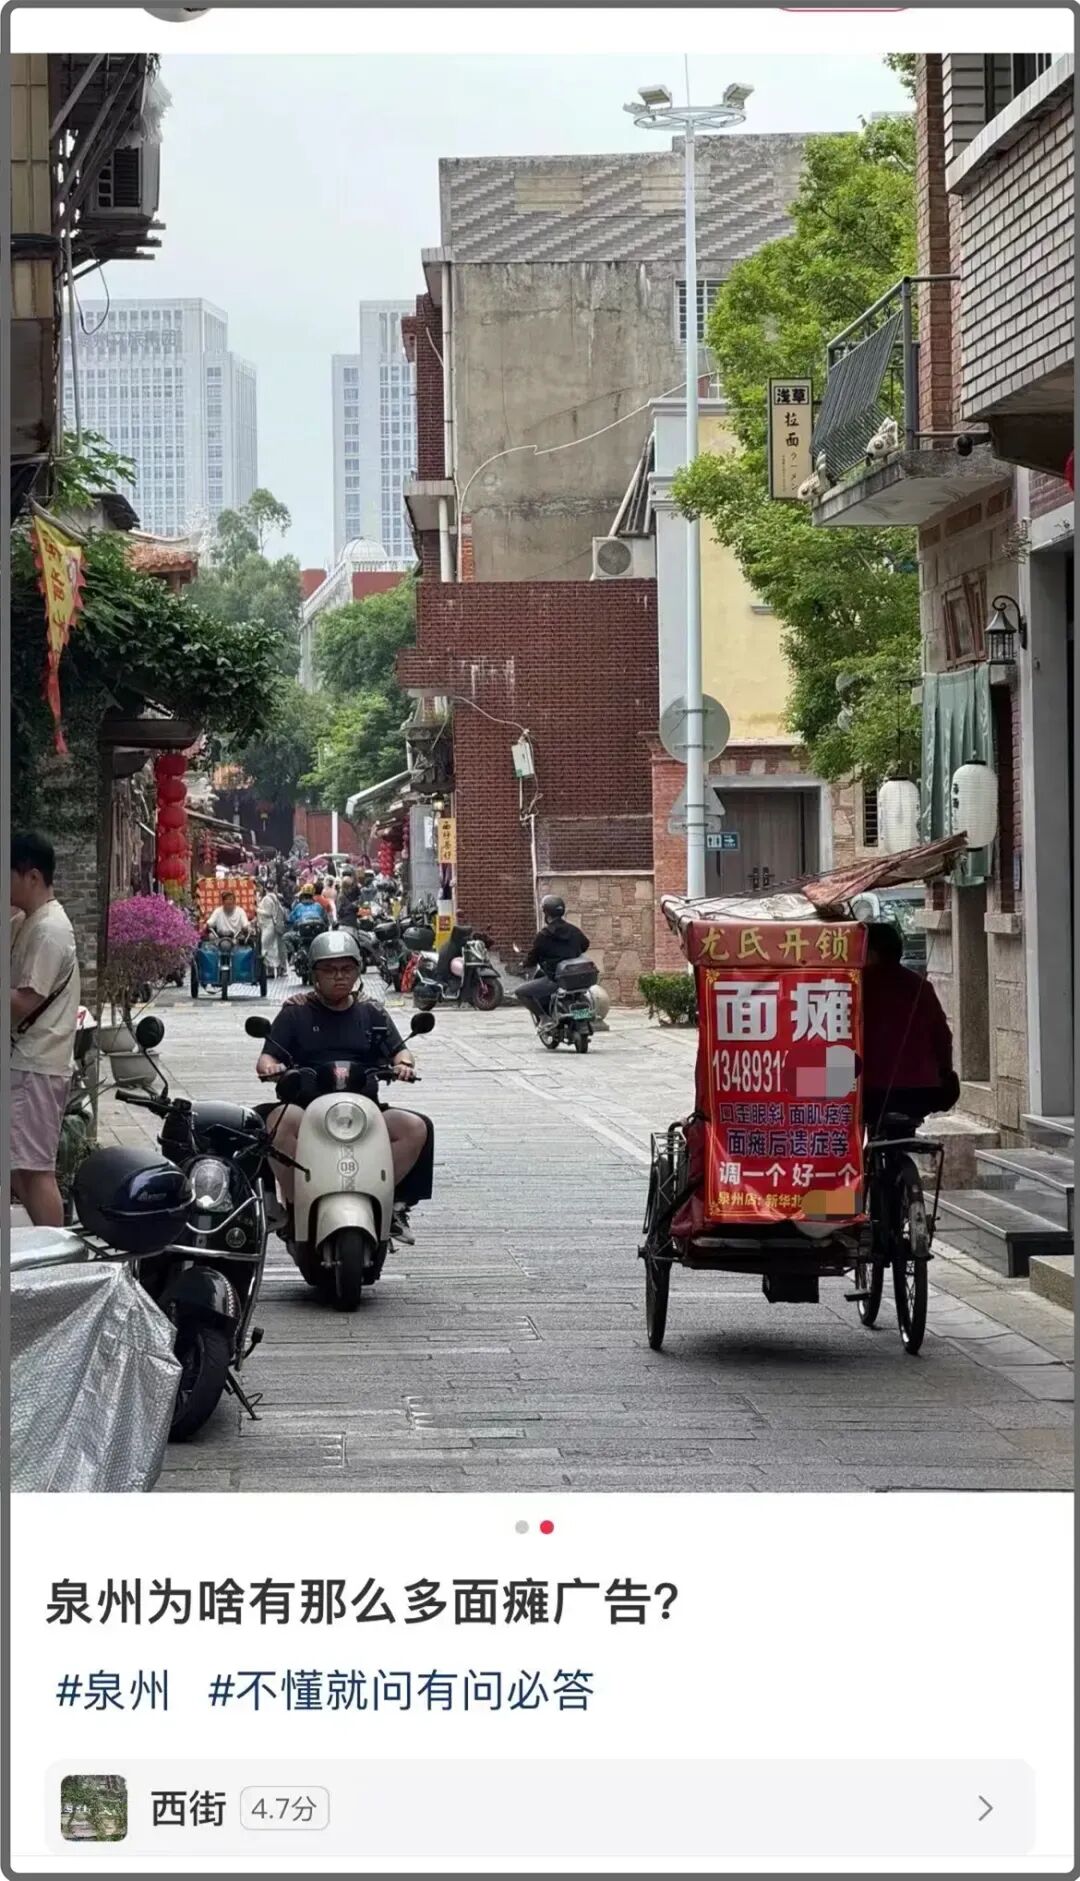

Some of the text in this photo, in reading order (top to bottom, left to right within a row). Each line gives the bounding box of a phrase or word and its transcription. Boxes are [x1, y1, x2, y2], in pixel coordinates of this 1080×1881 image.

[784, 411, 799, 447] 拉面
[697, 926, 851, 962] 尤氏开锁
[713, 979, 853, 1042] 面瘫
[720, 1103, 784, 1126] 口歪眼斜
[727, 1128, 850, 1158] 面瘫后遗症等
[719, 1162, 858, 1187] 调一个 好一个
